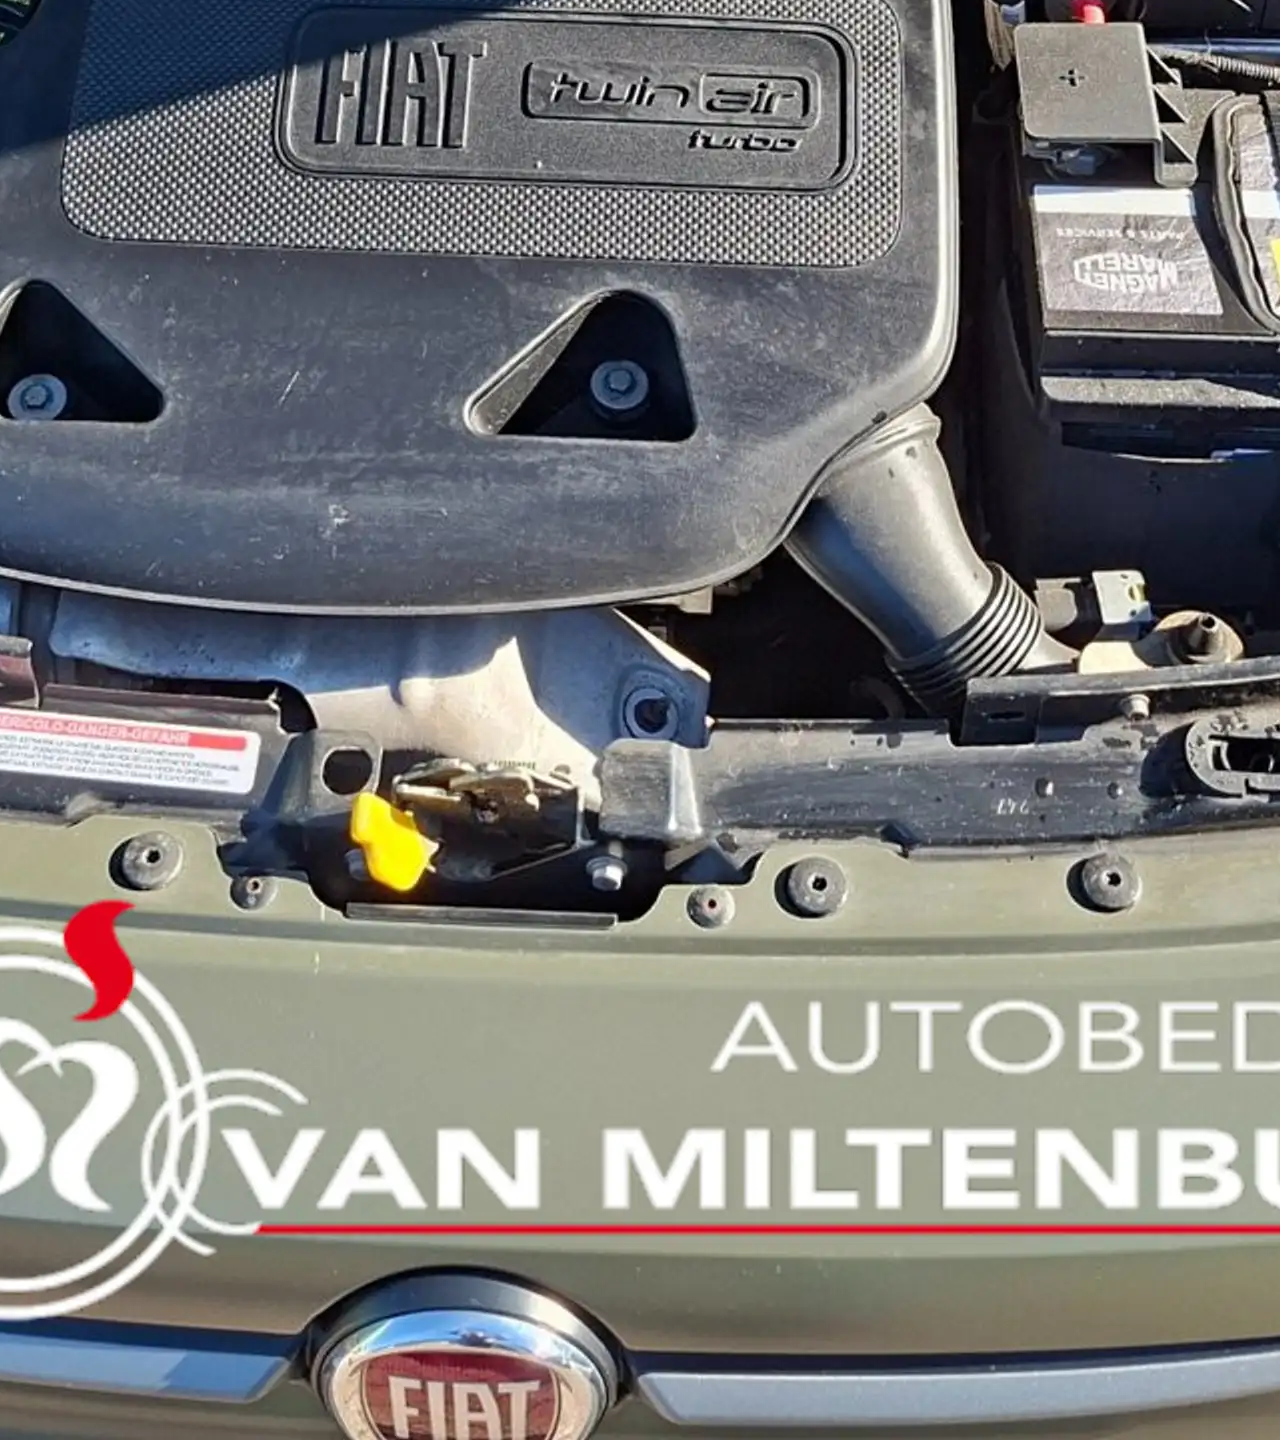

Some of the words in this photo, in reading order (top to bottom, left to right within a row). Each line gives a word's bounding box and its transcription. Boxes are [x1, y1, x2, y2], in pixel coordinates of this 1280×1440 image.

[316, 39, 487, 150] FIAT
[688, 130, 803, 154] turbo
[388, 1375, 541, 1440] FIAT
